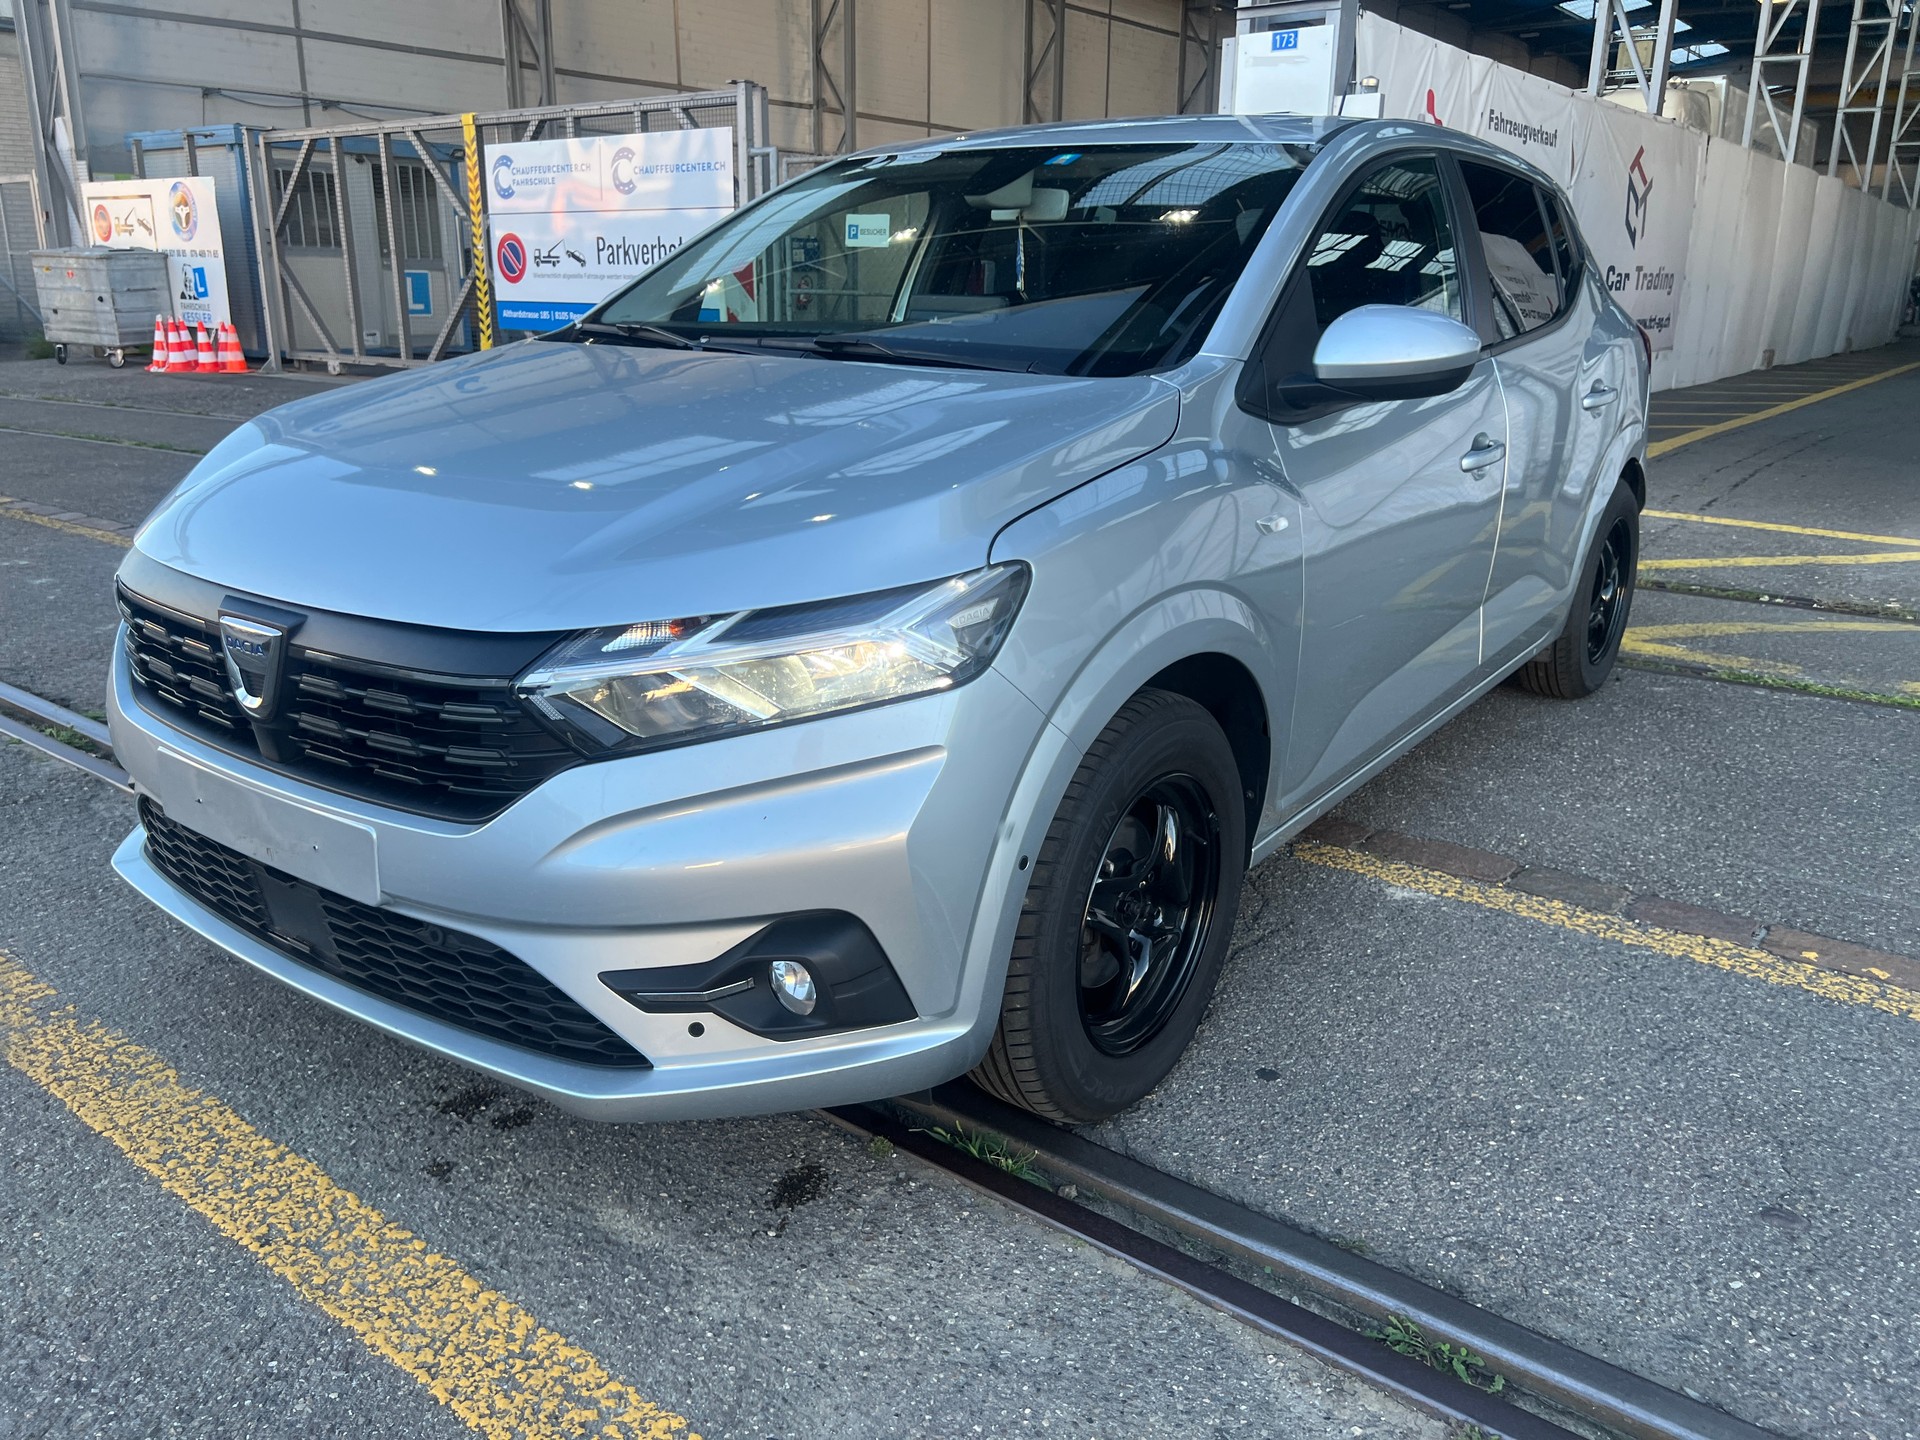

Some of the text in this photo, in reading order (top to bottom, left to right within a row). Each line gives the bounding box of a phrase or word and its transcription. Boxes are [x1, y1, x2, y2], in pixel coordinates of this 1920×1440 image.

[1275, 33, 1295, 48] 173
[1488, 109, 1558, 148] Fahrzeugverkauf
[511, 163, 591, 176] CHAUFFEURCENTER.CH
[633, 161, 726, 175] CHAUFFEURCENTER.CH
[512, 177, 556, 187] FAHRSCHULE
[1606, 265, 1675, 296] Car Trading
[958, 606, 992, 626] DACIA
[226, 634, 268, 658] DACIA
